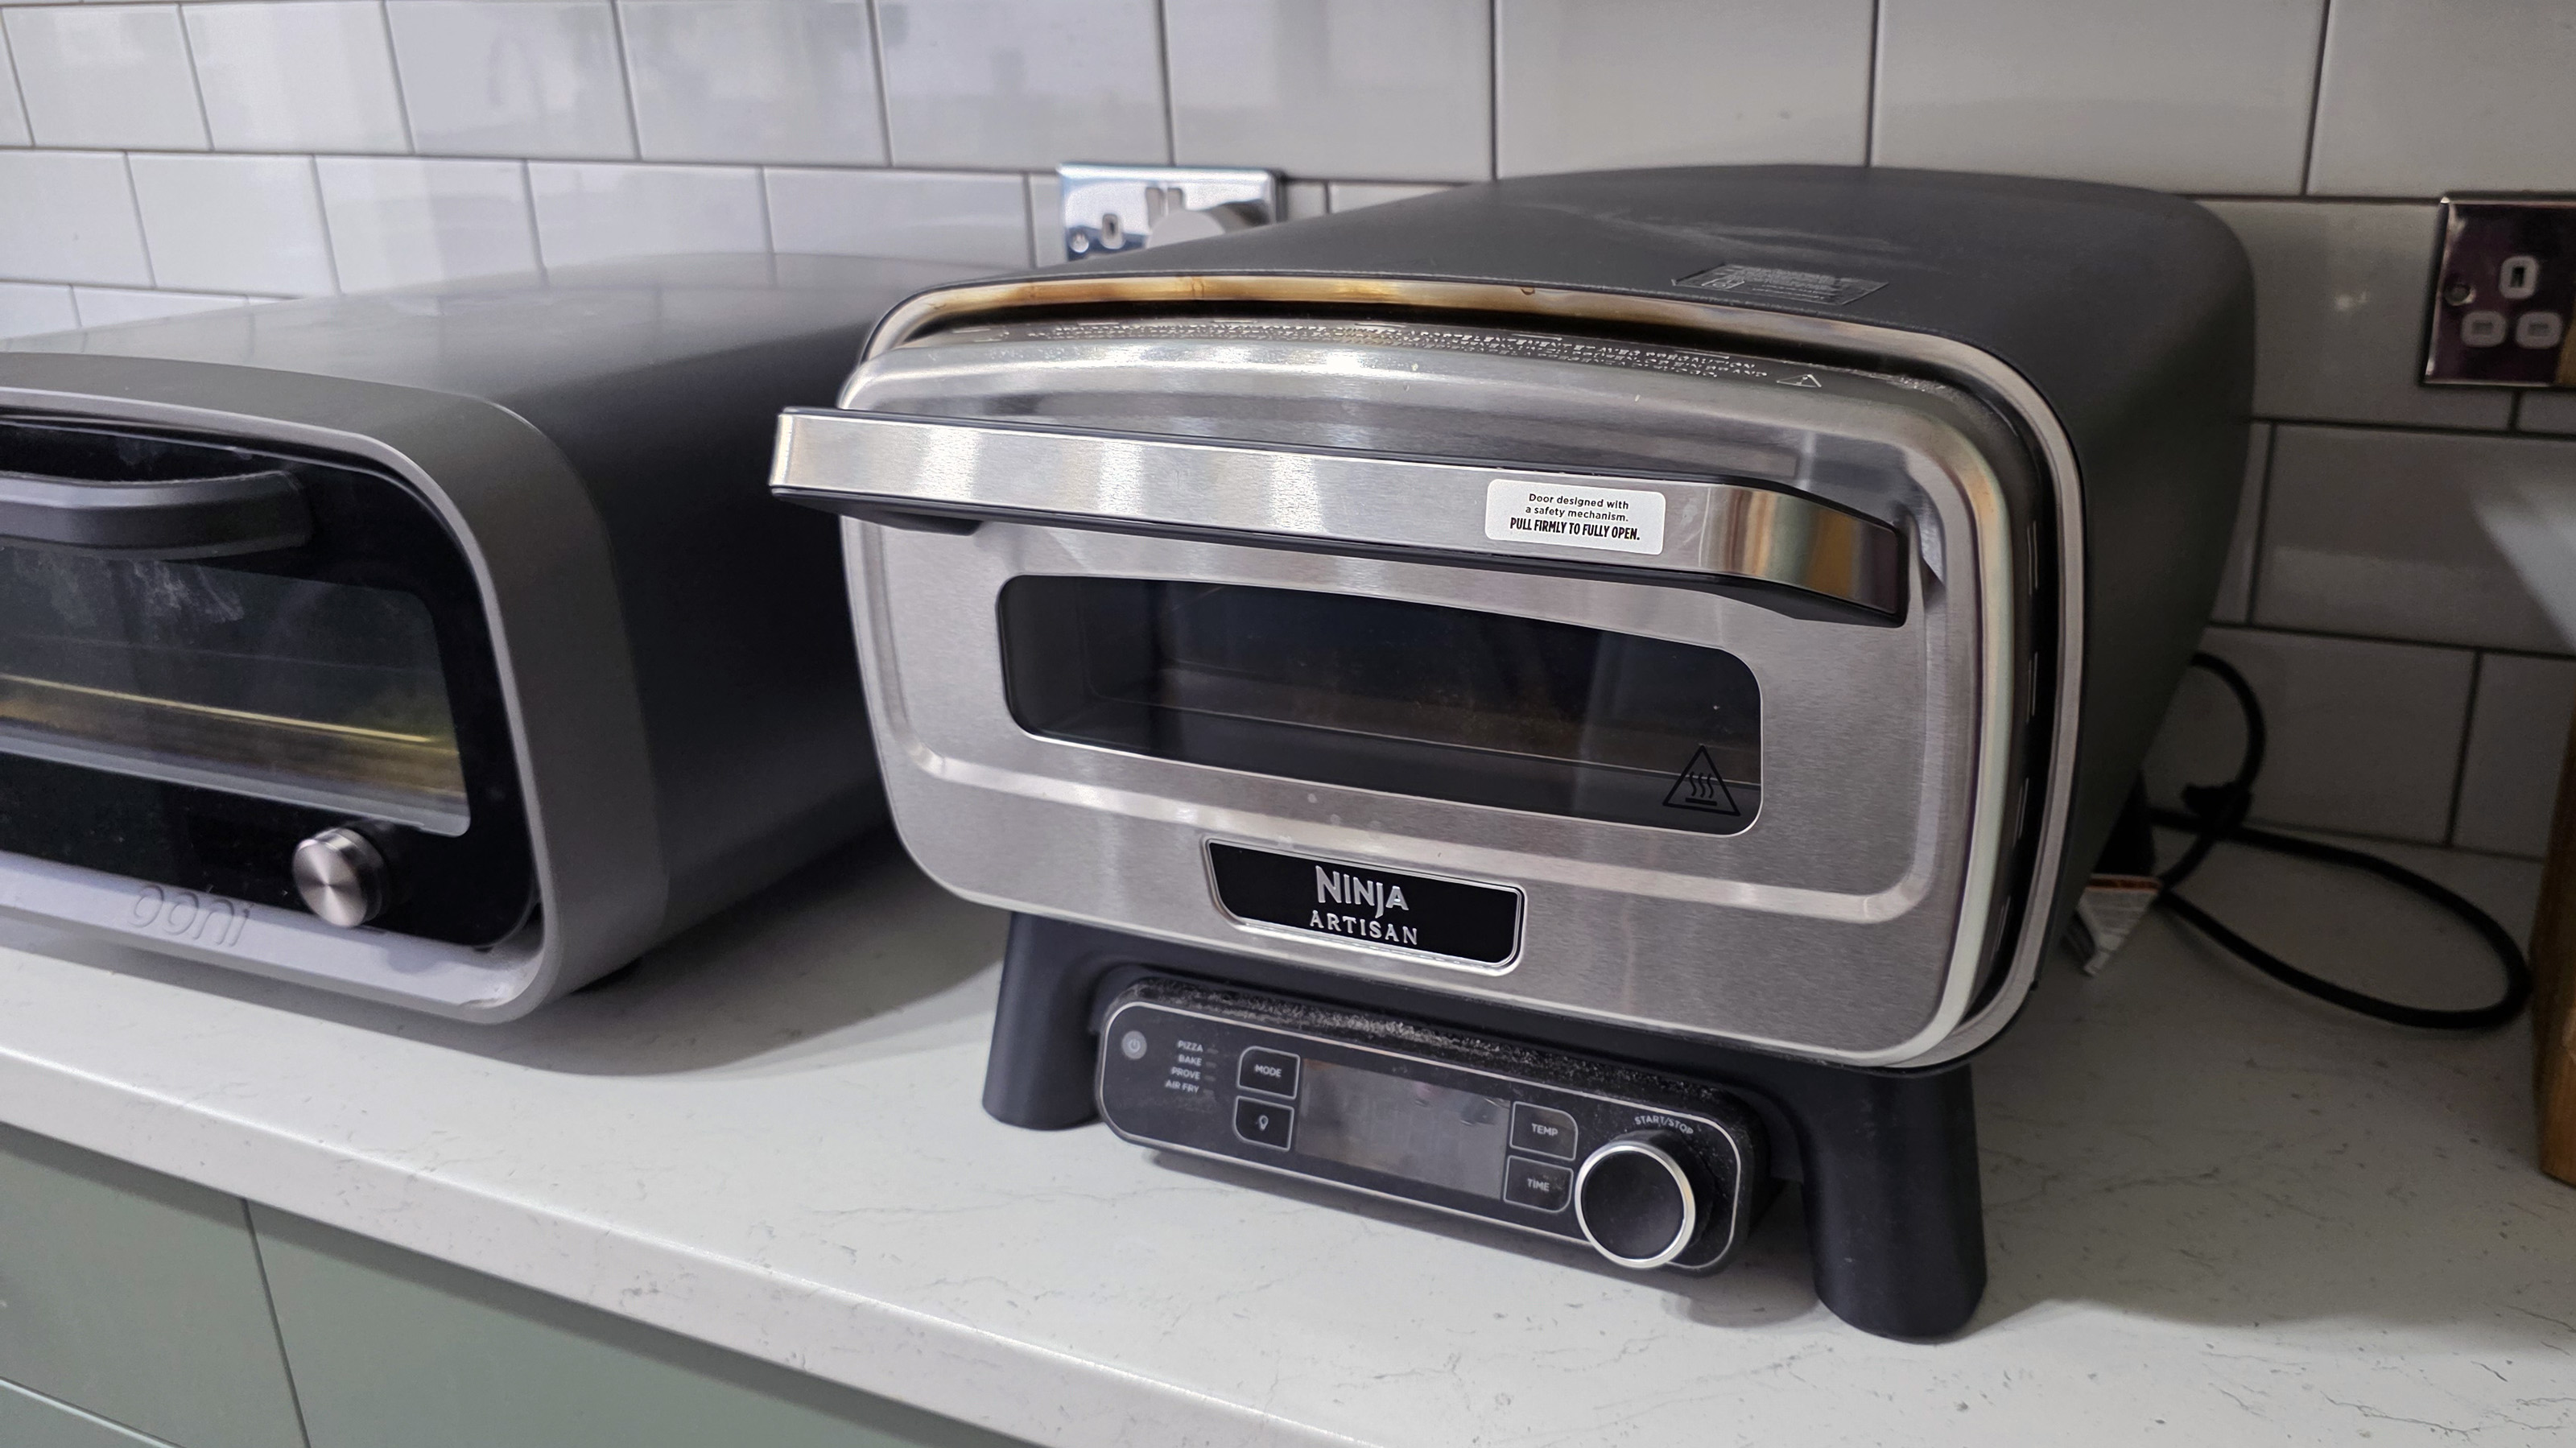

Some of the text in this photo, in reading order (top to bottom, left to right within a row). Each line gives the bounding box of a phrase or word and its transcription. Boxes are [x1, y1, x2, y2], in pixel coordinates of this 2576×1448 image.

[1529, 493, 1629, 509] Door designed with
[1534, 506, 1565, 518] safety
[1567, 509, 1629, 522] mechanism.
[1509, 517, 1641, 541] PULL FIRMLY TO FULLY OPEN.
[1315, 865, 1409, 918] NINJA
[129, 885, 255, 948] ooni
[1310, 910, 1418, 946] ARTISAN
[1178, 1040, 1203, 1052] PIZZA
[1179, 1054, 1202, 1066] BAKE
[1170, 1066, 1201, 1080] PROVE
[1254, 1064, 1282, 1078] MODE
[1166, 1079, 1199, 1093] AIR FRY
[1531, 1123, 1558, 1137] TEMP
[1635, 1116, 1694, 1135] START/STOP
[1527, 1178, 1550, 1192] TIME
